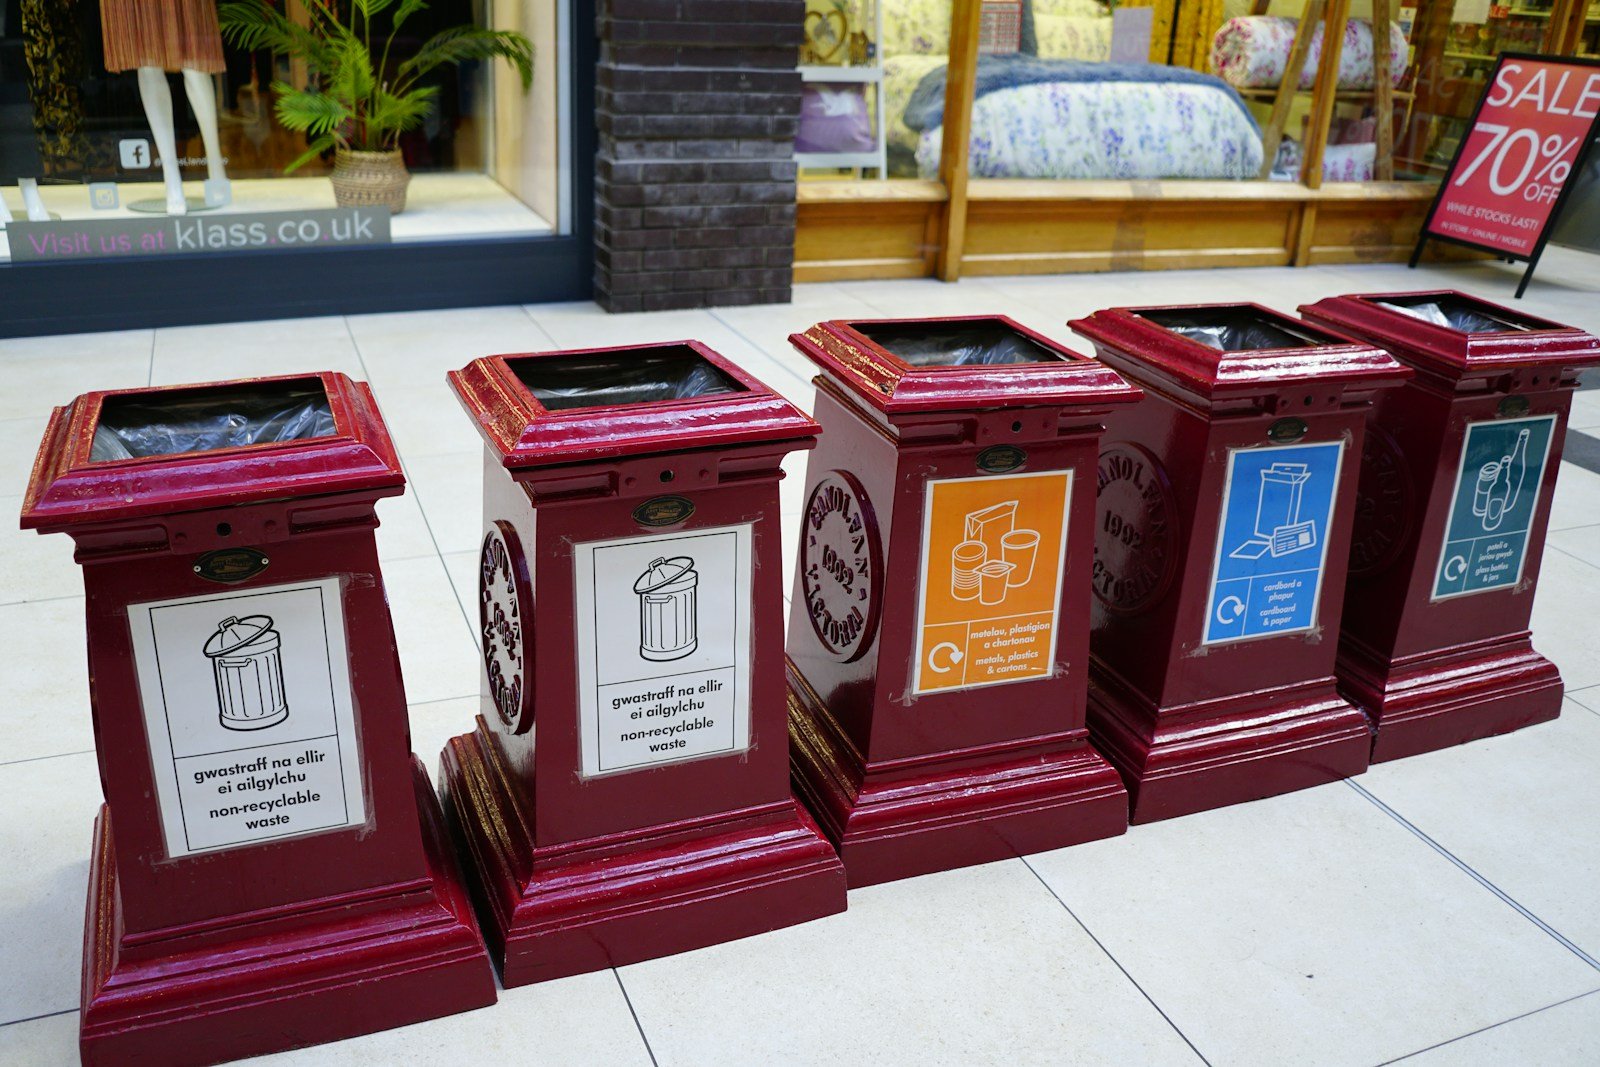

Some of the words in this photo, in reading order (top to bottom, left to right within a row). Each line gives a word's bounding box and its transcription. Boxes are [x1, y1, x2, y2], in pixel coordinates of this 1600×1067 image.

[1486, 64, 1600, 118] SALE
[1454, 122, 1579, 196] 70%
[1523, 183, 1562, 204] OFF
[1446, 201, 1474, 217] WHILE
[1475, 207, 1511, 225] STOCKS
[1511, 216, 1539, 231] LAST!
[29, 232, 90, 256] Visit
[101, 233, 131, 252] us
[141, 231, 165, 249] at
[174, 210, 373, 250] klass.co.uk
[1472, 228, 1498, 241] ONLINE
[1502, 235, 1528, 248] MOBILE
[822, 544, 854, 595] 1992
[1263, 579, 1296, 591] cardbord
[806, 563, 865, 647] VICTORIA
[1268, 592, 1294, 603] phapur
[1260, 603, 1296, 616] cardboard
[970, 626, 1007, 640] metelau,
[1009, 622, 1050, 635] plastigion
[1263, 618, 1269, 626] &
[1270, 616, 1292, 627] paper
[992, 636, 1036, 648] chartonau
[975, 653, 1006, 666] metals,
[1008, 650, 1039, 663] plastics
[987, 665, 994, 675] &
[997, 663, 1028, 673] cartons
[612, 685, 674, 710] gwastraff
[678, 687, 694, 697] na
[698, 680, 723, 694] ellir
[630, 707, 642, 719] ei
[646, 699, 705, 717] ailgylchu
[620, 717, 714, 741] non-recyclable
[649, 738, 686, 752] waste
[194, 757, 268, 784] gwastraff
[272, 758, 291, 769] na
[296, 750, 325, 764] ellir
[217, 781, 231, 794] ei
[237, 771, 306, 791] ailgylchu
[209, 789, 321, 818] non-recyclable
[245, 814, 290, 829] waste
